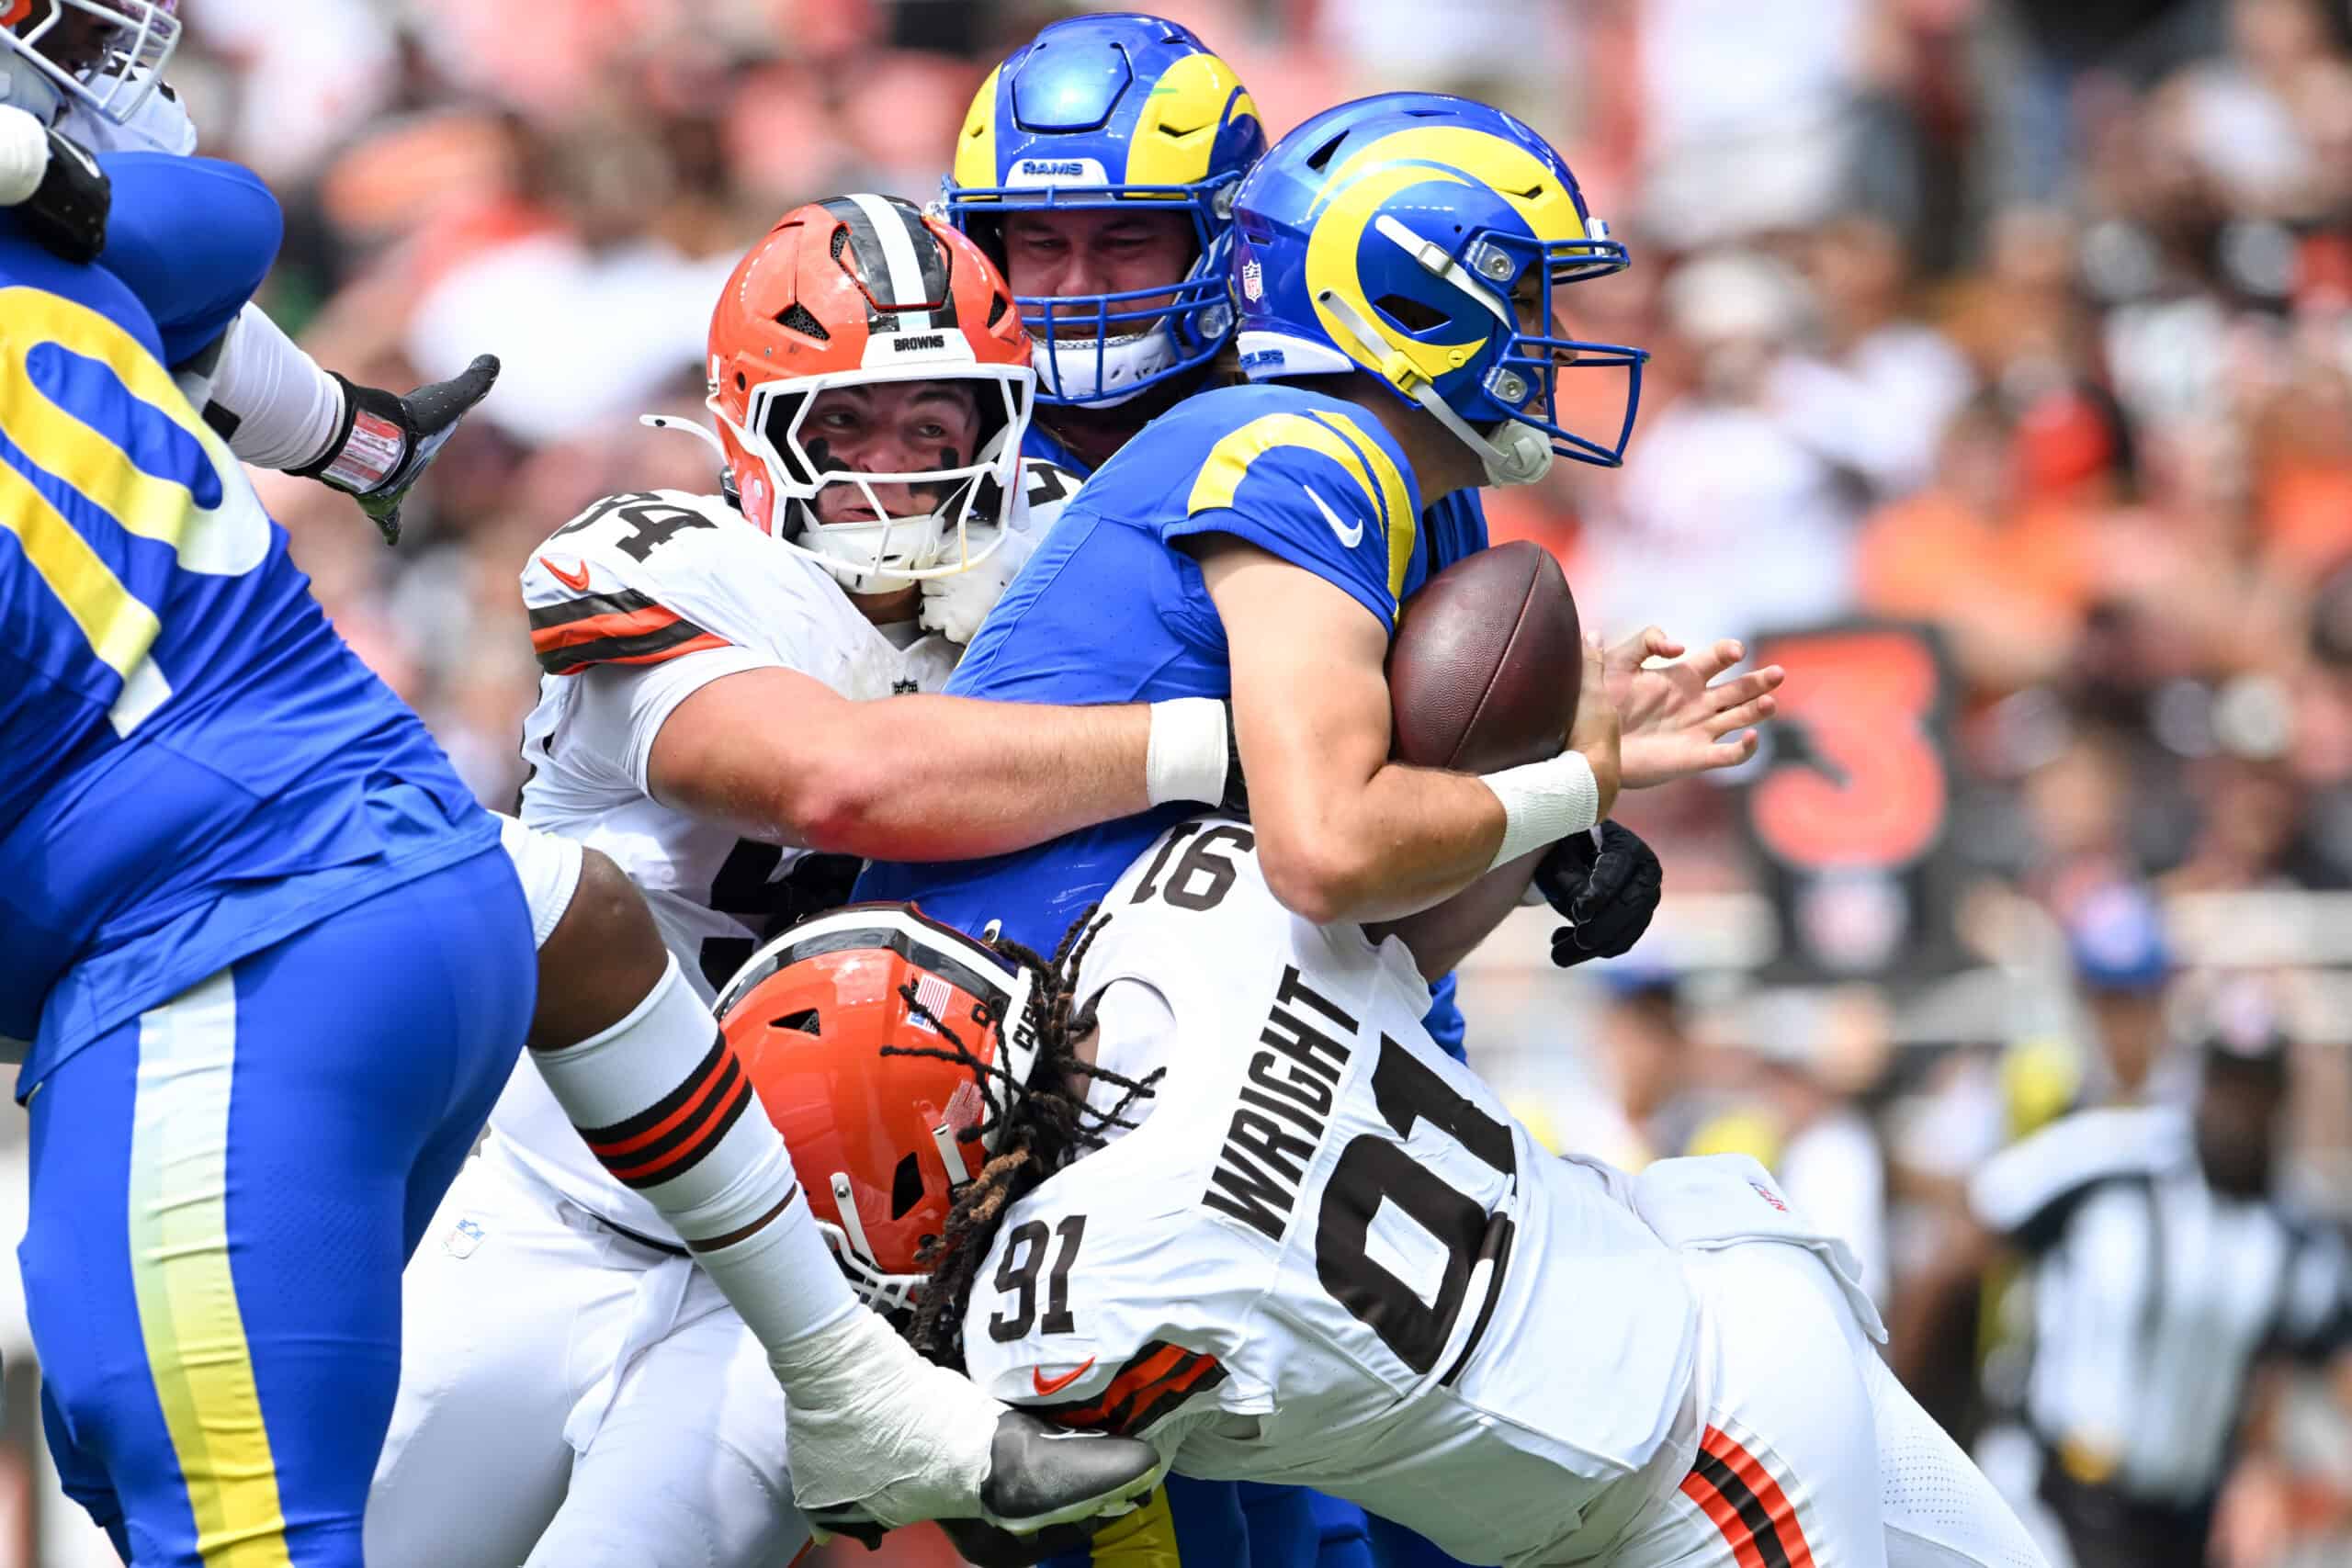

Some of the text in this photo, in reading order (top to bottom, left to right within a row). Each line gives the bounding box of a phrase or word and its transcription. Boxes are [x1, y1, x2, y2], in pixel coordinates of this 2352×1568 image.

[1022, 161, 1083, 175] RAMS
[894, 334, 944, 352] BROWNS
[1128, 822, 1255, 911] 91
[1201, 964, 1360, 1243] WRIGHT
[989, 1214, 1087, 1343] 91
